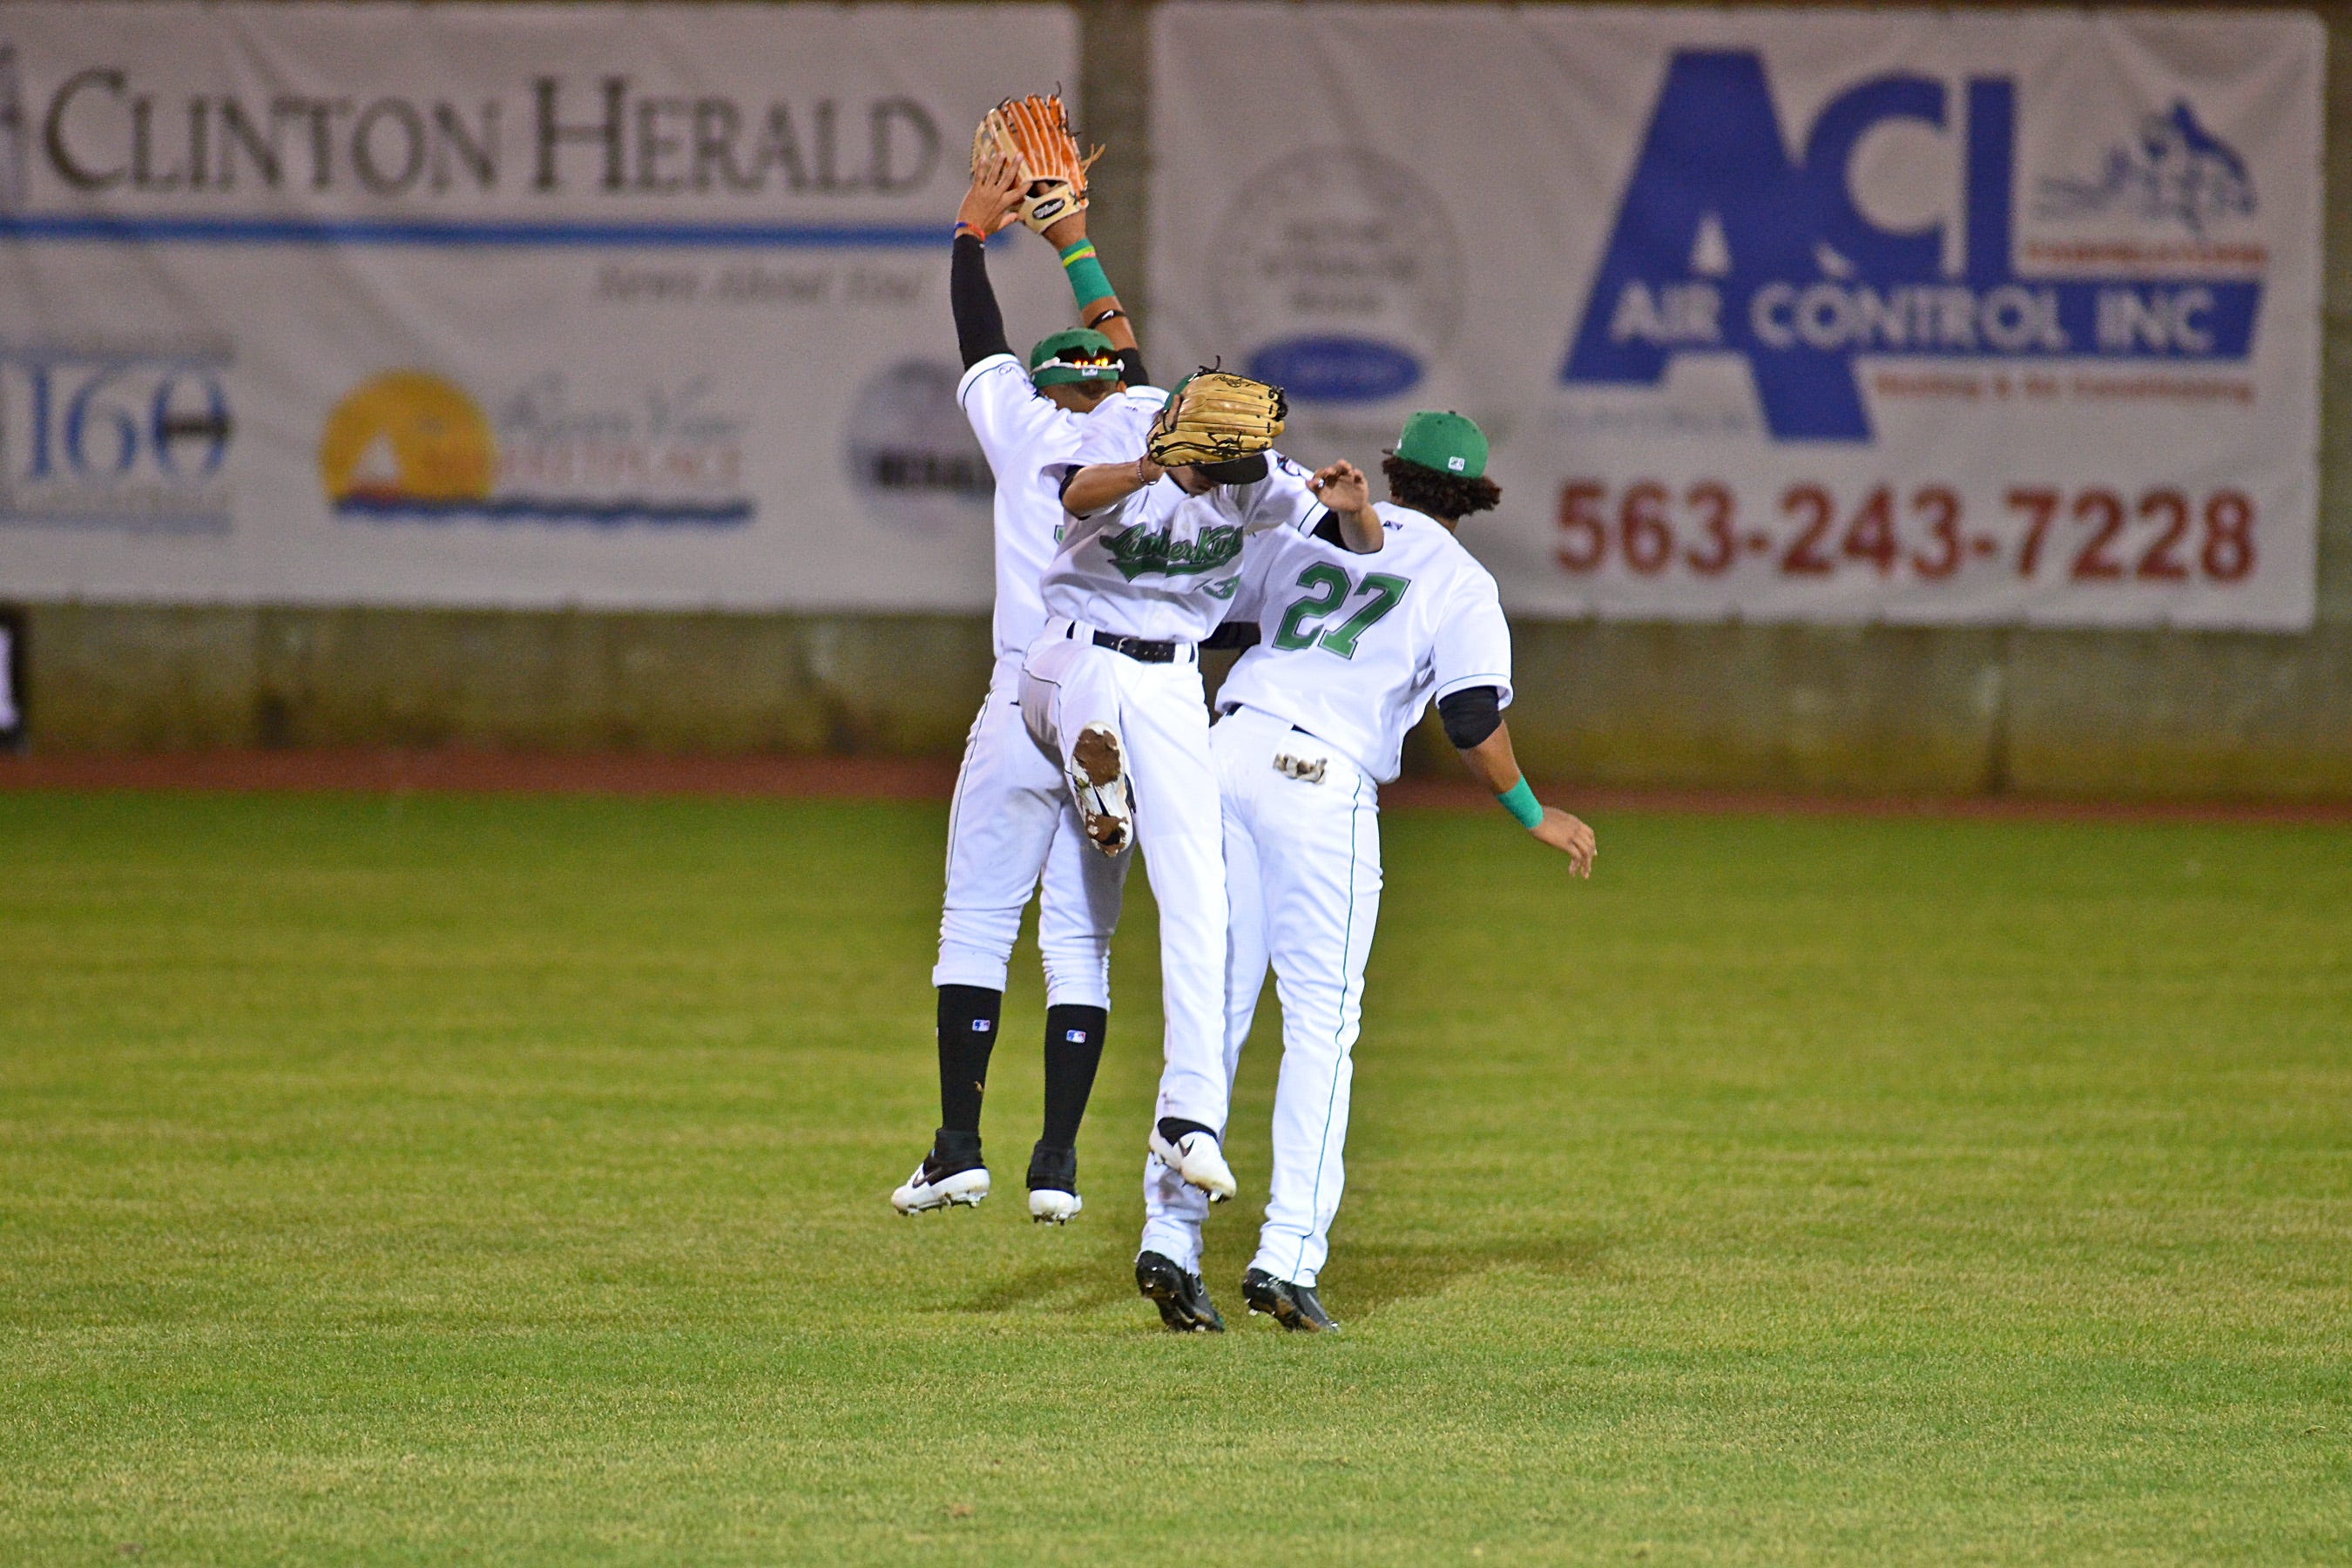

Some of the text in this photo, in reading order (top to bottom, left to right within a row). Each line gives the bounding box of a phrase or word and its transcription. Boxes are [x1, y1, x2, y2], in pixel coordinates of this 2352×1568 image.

[43, 66, 943, 197] CLINTON HERALD
[1608, 282, 2216, 351] AIR CONTROL INC
[1554, 478, 2258, 585] 563-243-7228
[1271, 559, 1412, 661] 27
